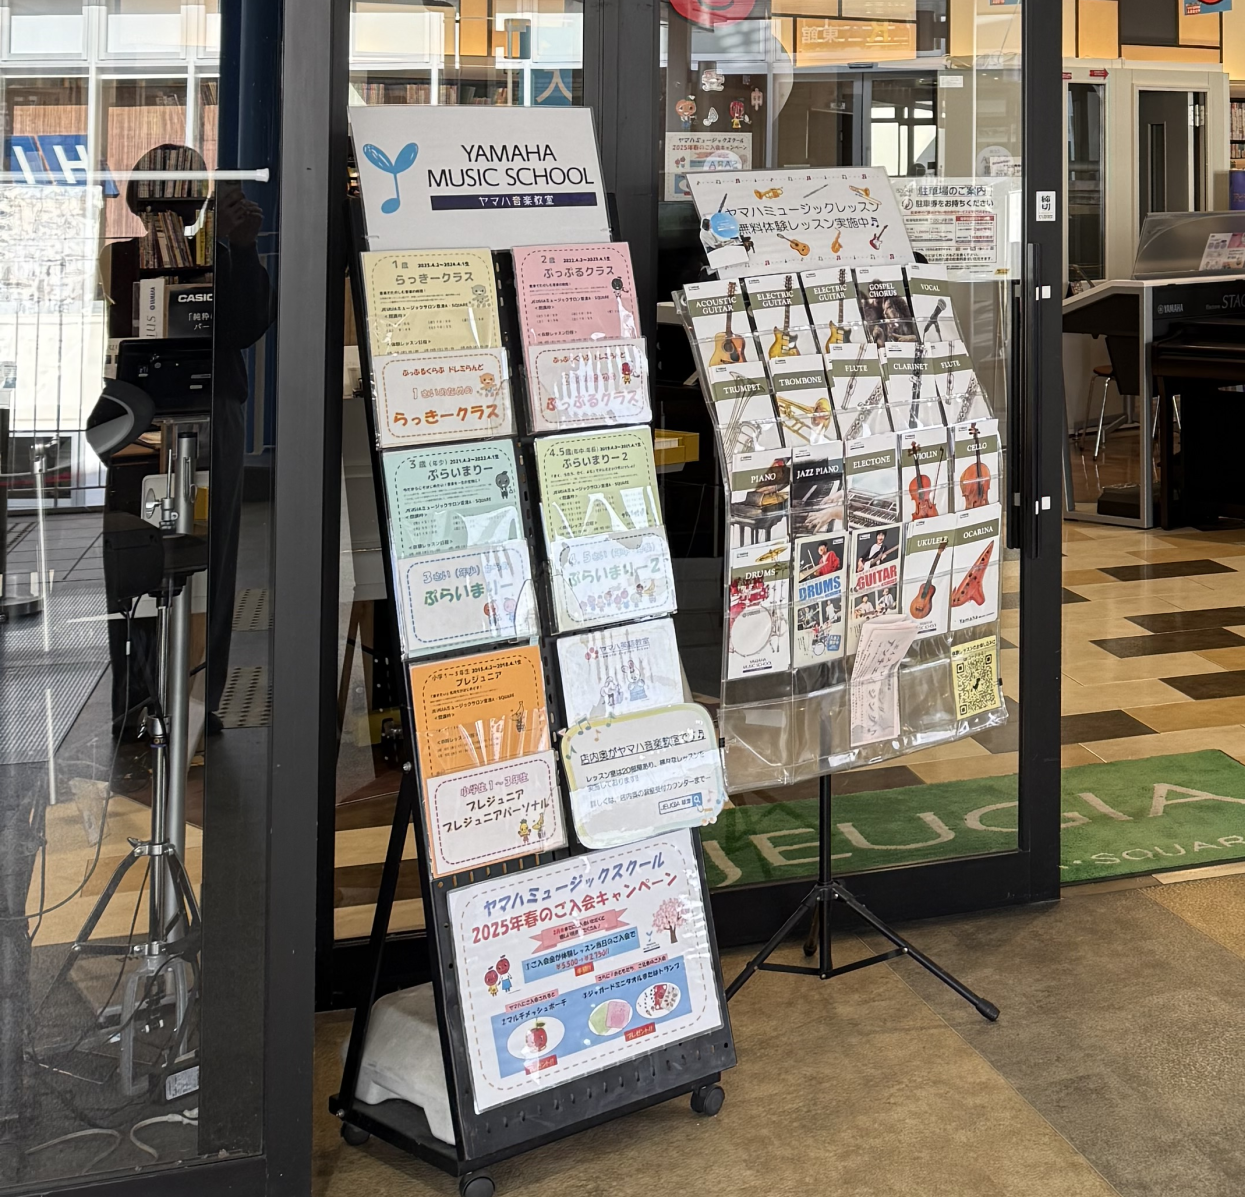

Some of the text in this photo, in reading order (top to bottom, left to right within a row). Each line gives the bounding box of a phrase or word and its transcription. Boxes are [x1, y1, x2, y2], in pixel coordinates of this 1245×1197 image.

[461, 144, 557, 162] YAMAHA
[428, 167, 594, 188] MUSIC SCHOOL
[478, 195, 555, 206] ヤマハ音楽教室
[725, 201, 879, 217] ヤマハミュージックレッスン
[738, 217, 869, 236] 無料体験レッスン実施中
[395, 271, 475, 285] らっきークラス
[543, 266, 615, 279] ぷっぷるクラス
[814, 284, 847, 294] ELECTRIC
[868, 282, 895, 291] GOSPEL
[920, 283, 941, 292] VOCAL
[756, 291, 794, 300] ELECTRIC
[818, 292, 846, 301] GUITAR
[868, 289, 898, 298] CHORUS
[696, 296, 737, 308] ACOUSTIC
[762, 298, 793, 308] GUITAR
[1163, 303, 1183, 313] YAMAHA
[702, 305, 734, 314] GUITAR
[844, 364, 868, 372] FLUTE
[941, 360, 961, 369] FLUTE
[778, 376, 823, 387] TROMBONE
[723, 383, 761, 394] TRUMPET
[393, 403, 500, 426] らっきークラス
[966, 442, 987, 451] CELLO
[562, 452, 628, 469] ぷらいまりー2
[913, 449, 938, 460] VIOLIN
[853, 455, 891, 468] ELECTONE
[427, 464, 493, 481] ぷらいまりー
[751, 472, 777, 483] PIANO
[797, 464, 839, 479] JAZZ PIANO
[963, 526, 993, 539] OCARINA
[917, 536, 948, 547] UKULELE
[745, 568, 776, 580] DRUMS
[856, 564, 898, 591] GUITAR
[799, 576, 841, 601] DRUMS
[455, 671, 502, 686] プレジュニア
[466, 789, 525, 812] プレジュニア
[442, 798, 550, 833] プレジュニアパーソナル
[483, 852, 665, 917] ヤマハミュージックスクール
[471, 872, 678, 944] 2025年春のご入会キャンペーン
